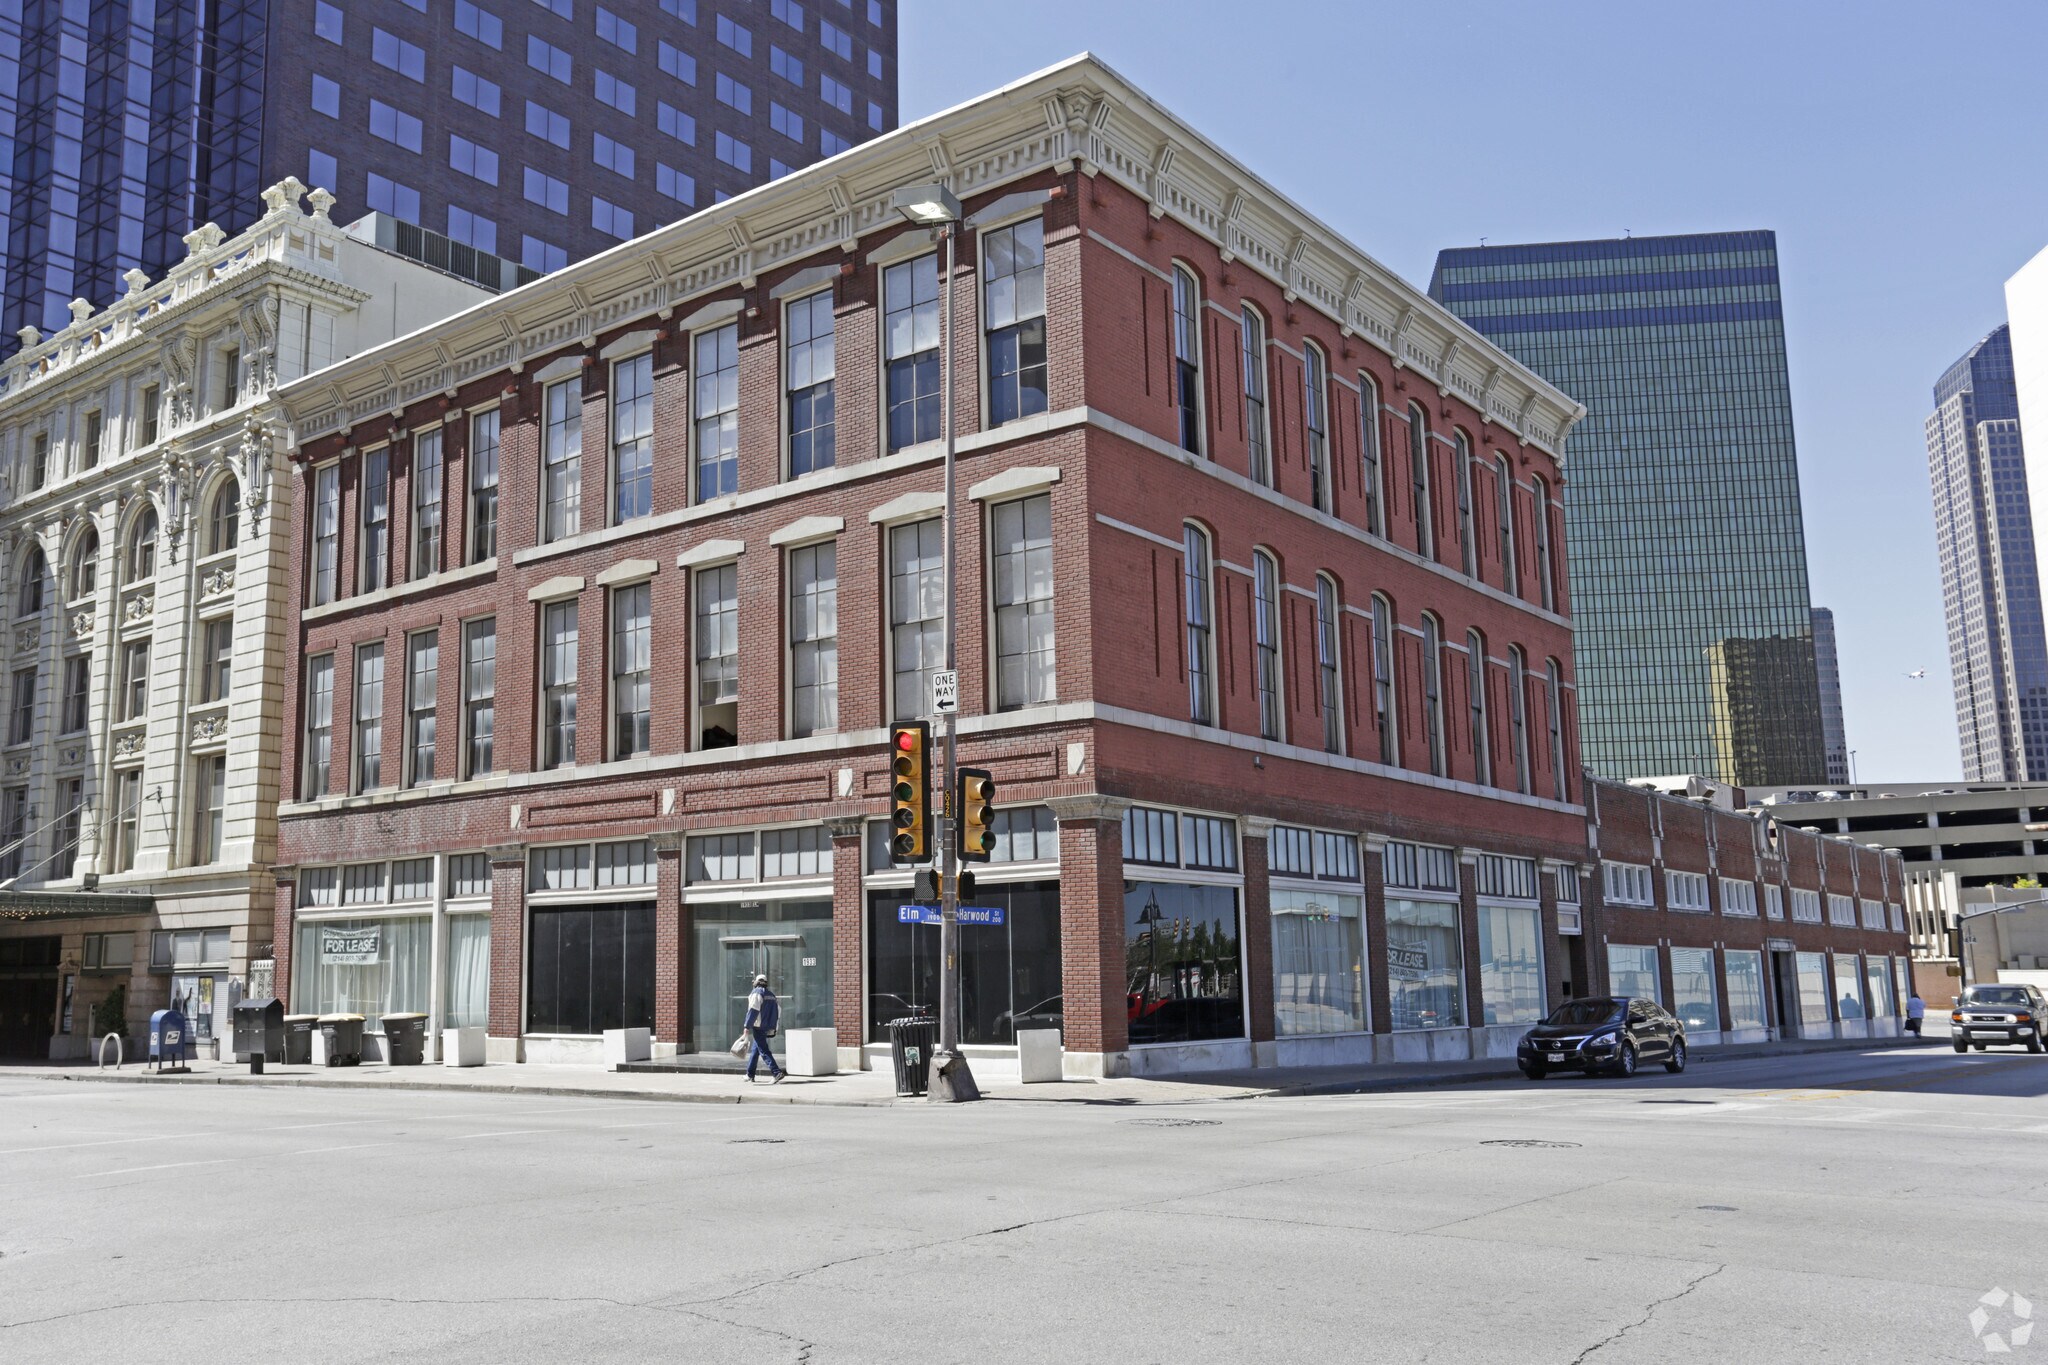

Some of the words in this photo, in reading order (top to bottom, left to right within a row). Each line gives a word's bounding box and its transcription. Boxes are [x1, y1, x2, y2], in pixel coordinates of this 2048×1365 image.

[935, 674, 954, 686] ONE
[935, 686, 955, 697] WAY
[900, 907, 919, 920] Elm
[960, 908, 990, 921] Harwood
[325, 940, 345, 952] FOR
[346, 939, 375, 952] LEASE
[1387, 948, 1398, 965] OR
[1399, 951, 1425, 968] LEASE
[1389, 966, 1399, 977] 214)
